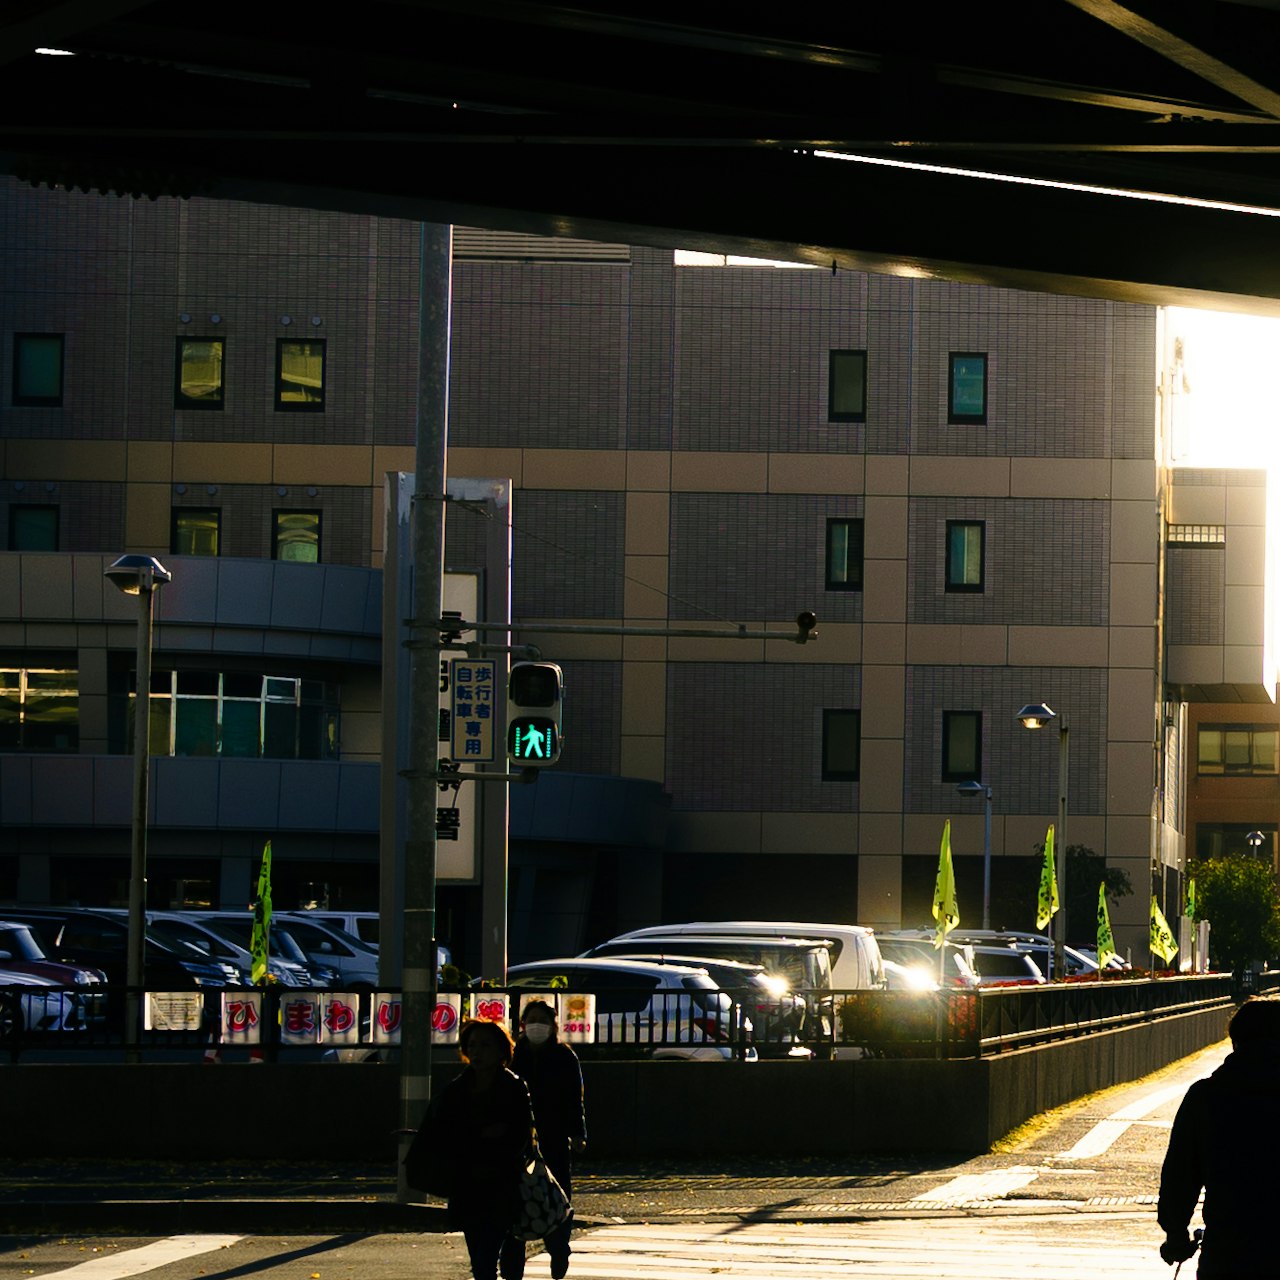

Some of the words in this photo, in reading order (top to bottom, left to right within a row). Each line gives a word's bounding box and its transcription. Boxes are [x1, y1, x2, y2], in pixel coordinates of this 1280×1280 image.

[456, 667, 472, 718] 自転車
[475, 667, 492, 719] 歩行者
[465, 721, 481, 755] 専用
